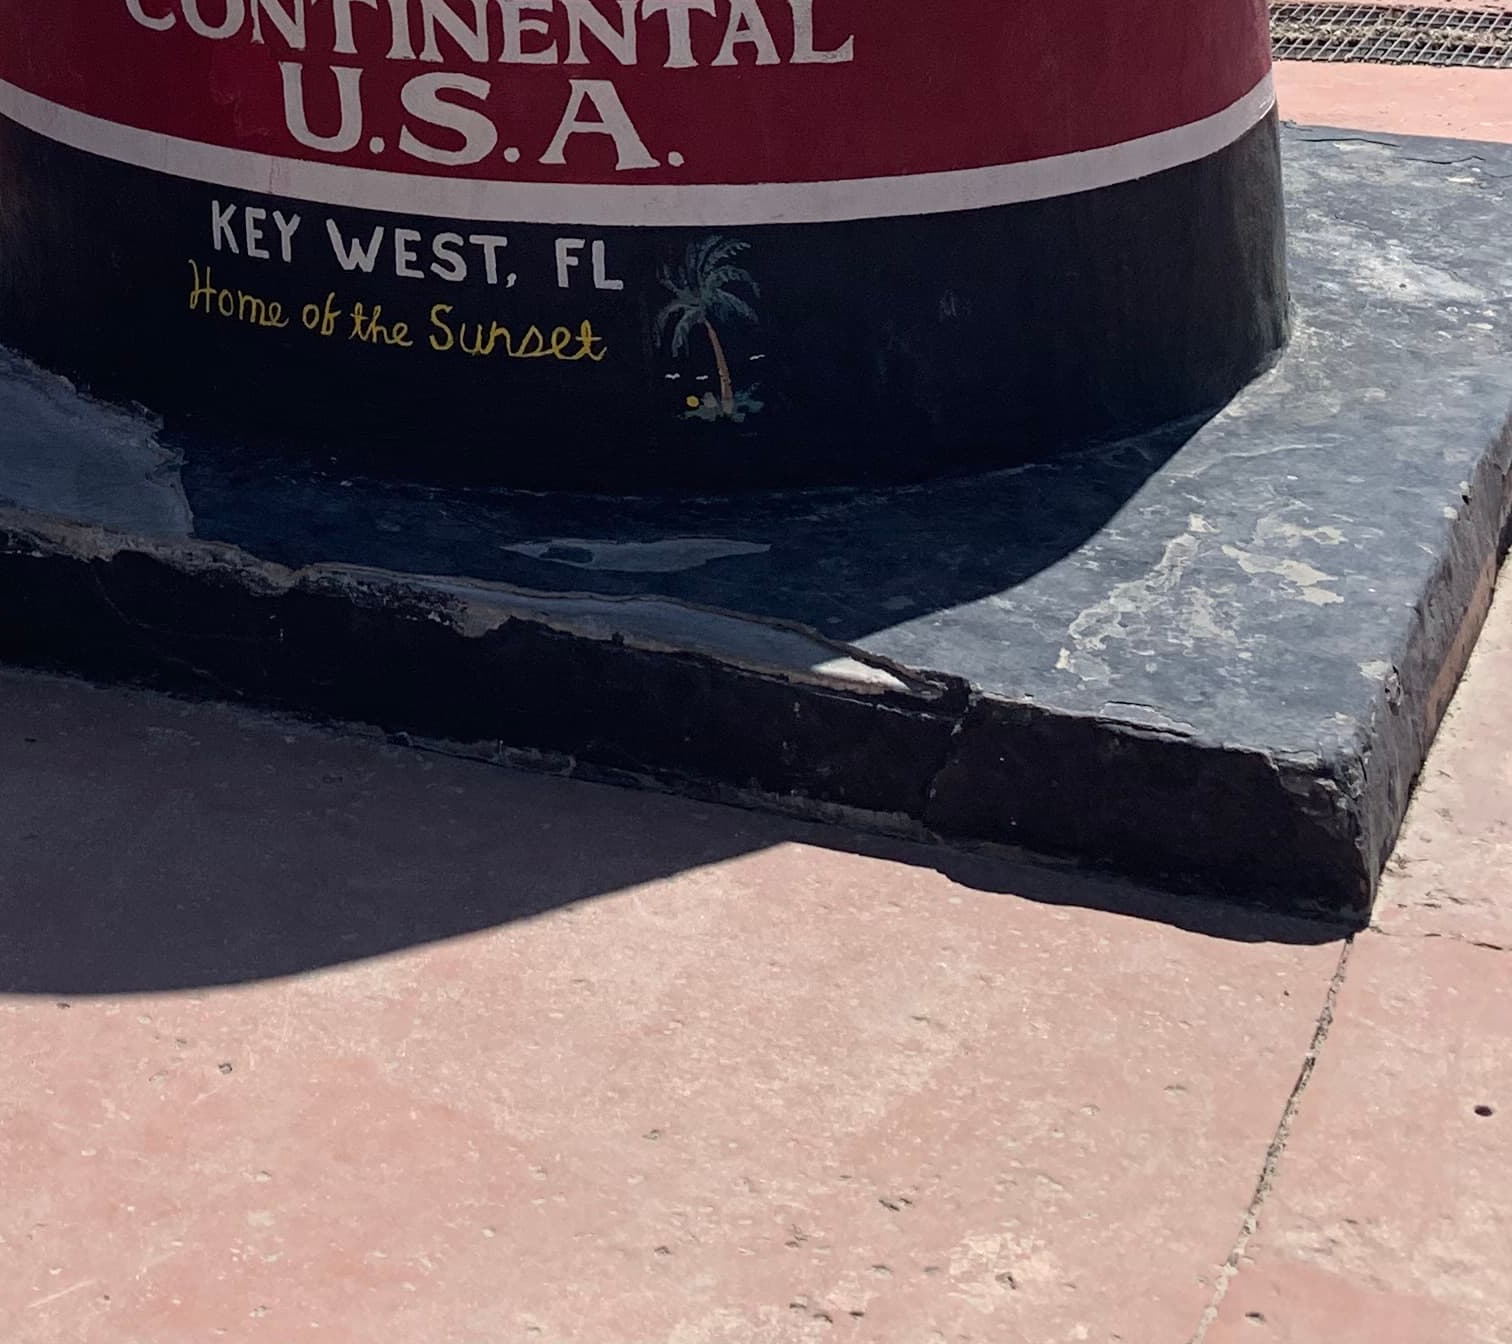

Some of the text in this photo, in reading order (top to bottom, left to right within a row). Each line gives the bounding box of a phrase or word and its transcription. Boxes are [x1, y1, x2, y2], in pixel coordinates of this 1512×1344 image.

[278, 59, 686, 171] U.S.A.
[211, 200, 624, 291] KEY WEST, FL
[188, 259, 608, 362] Home of the Sunset
